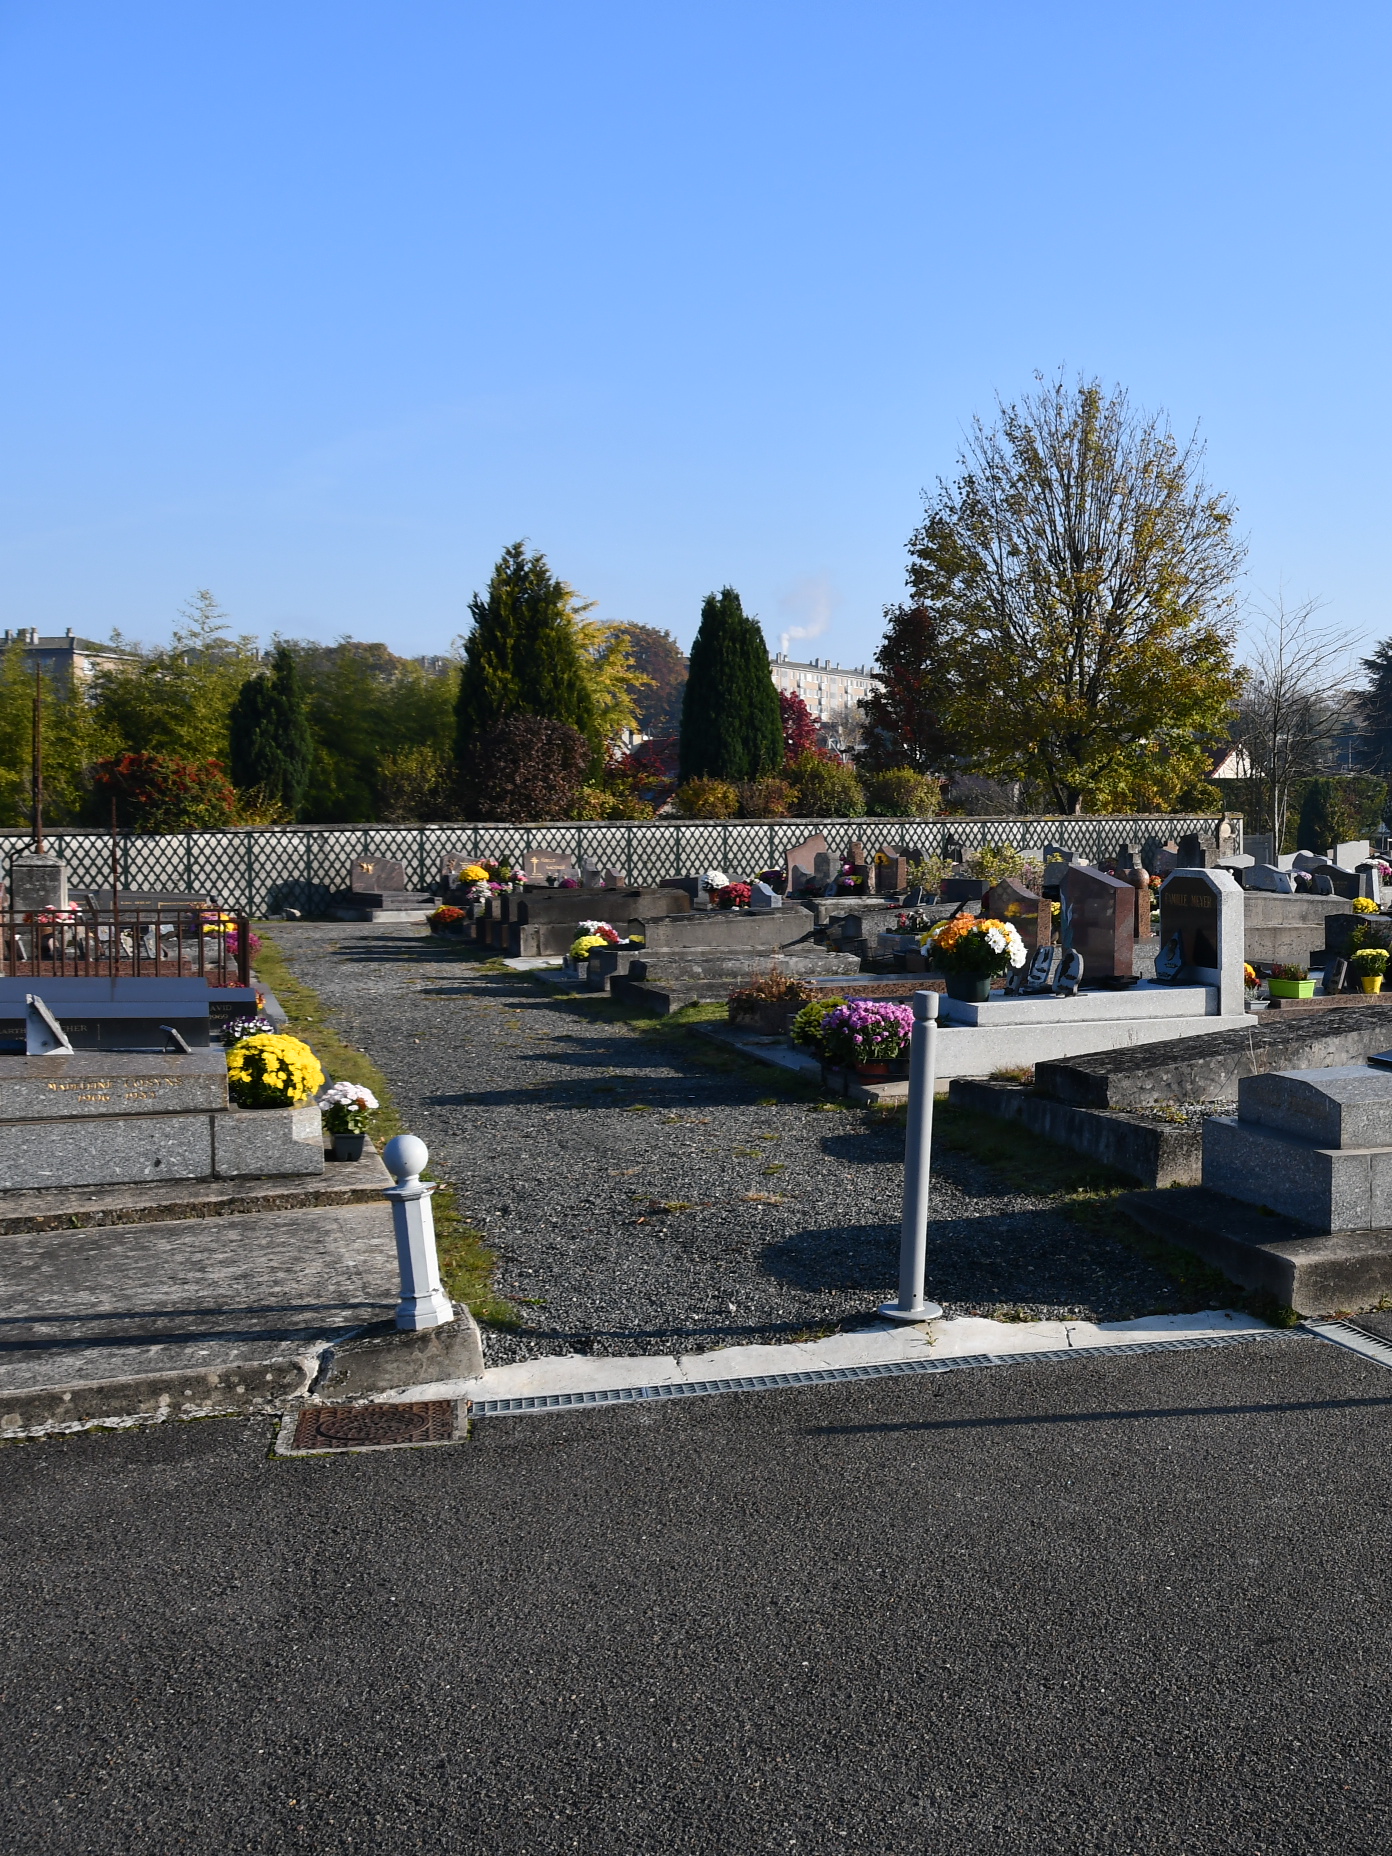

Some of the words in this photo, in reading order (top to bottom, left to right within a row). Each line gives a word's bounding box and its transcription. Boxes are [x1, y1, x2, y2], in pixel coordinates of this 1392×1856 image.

[1164, 892, 1188, 906] FAMILLE
[1191, 894, 1213, 908] MEYER
[209, 1004, 232, 1012] AVID
[0, 1027, 26, 1035] ARTH
[62, 1024, 88, 1032] CHER
[47, 1080, 113, 1092] MADELEINE
[124, 1077, 184, 1089] COSYNS
